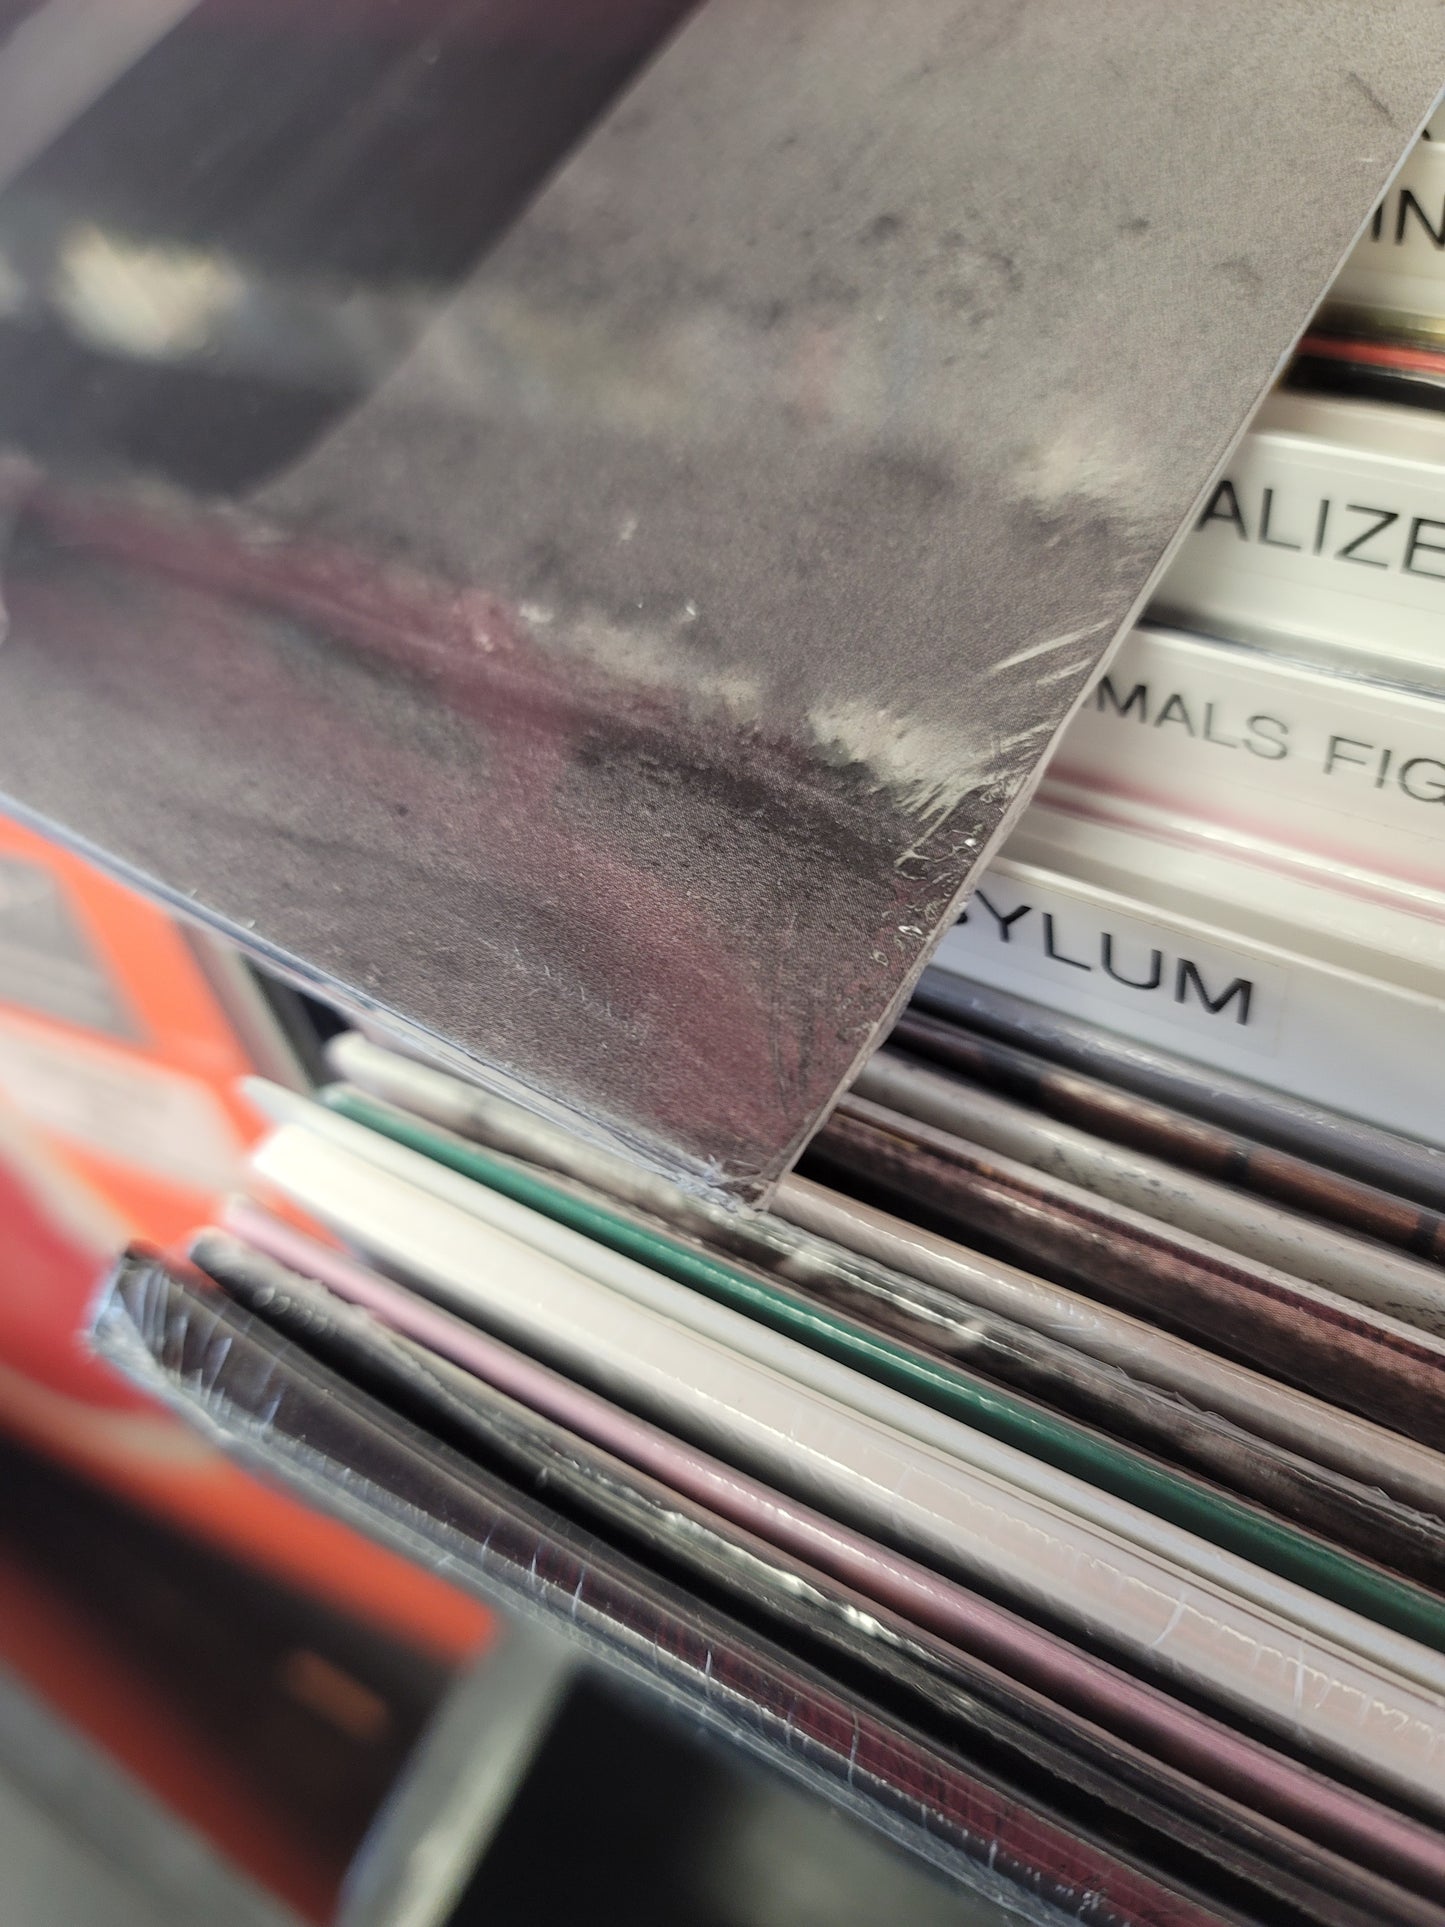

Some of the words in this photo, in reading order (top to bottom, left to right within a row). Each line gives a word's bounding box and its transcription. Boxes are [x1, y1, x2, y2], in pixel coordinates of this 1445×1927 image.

[1195, 480, 1445, 581] ALIZE
[1083, 675, 1289, 760] MALS
[1322, 735, 1445, 806] FIG
[954, 889, 1253, 1026] YLUM
